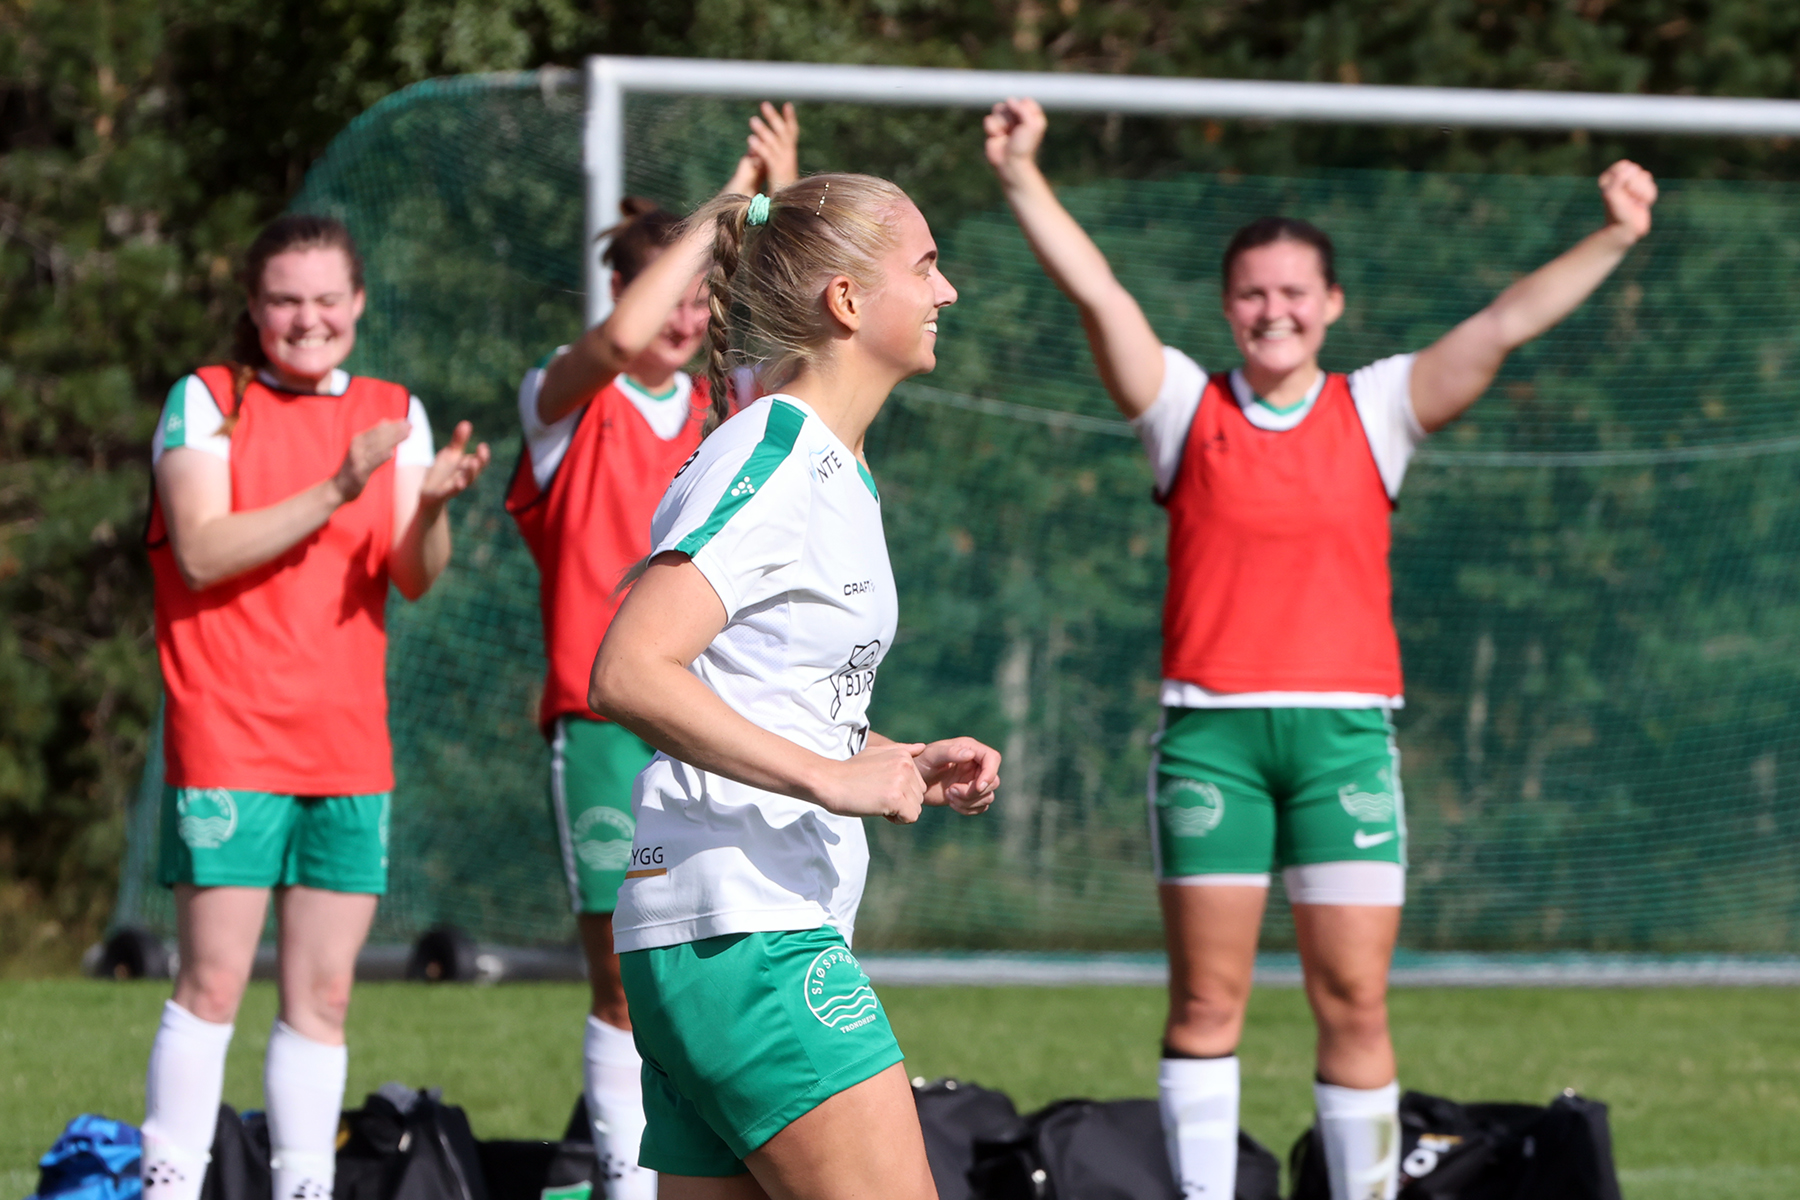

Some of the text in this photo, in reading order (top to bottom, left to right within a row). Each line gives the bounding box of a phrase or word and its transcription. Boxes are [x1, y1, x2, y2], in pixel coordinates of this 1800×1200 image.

[816, 450, 843, 484] NTE
[843, 580, 871, 597] CRAFT
[631, 846, 664, 866] YGG
[839, 1013, 877, 1034] TRONDHEIM
